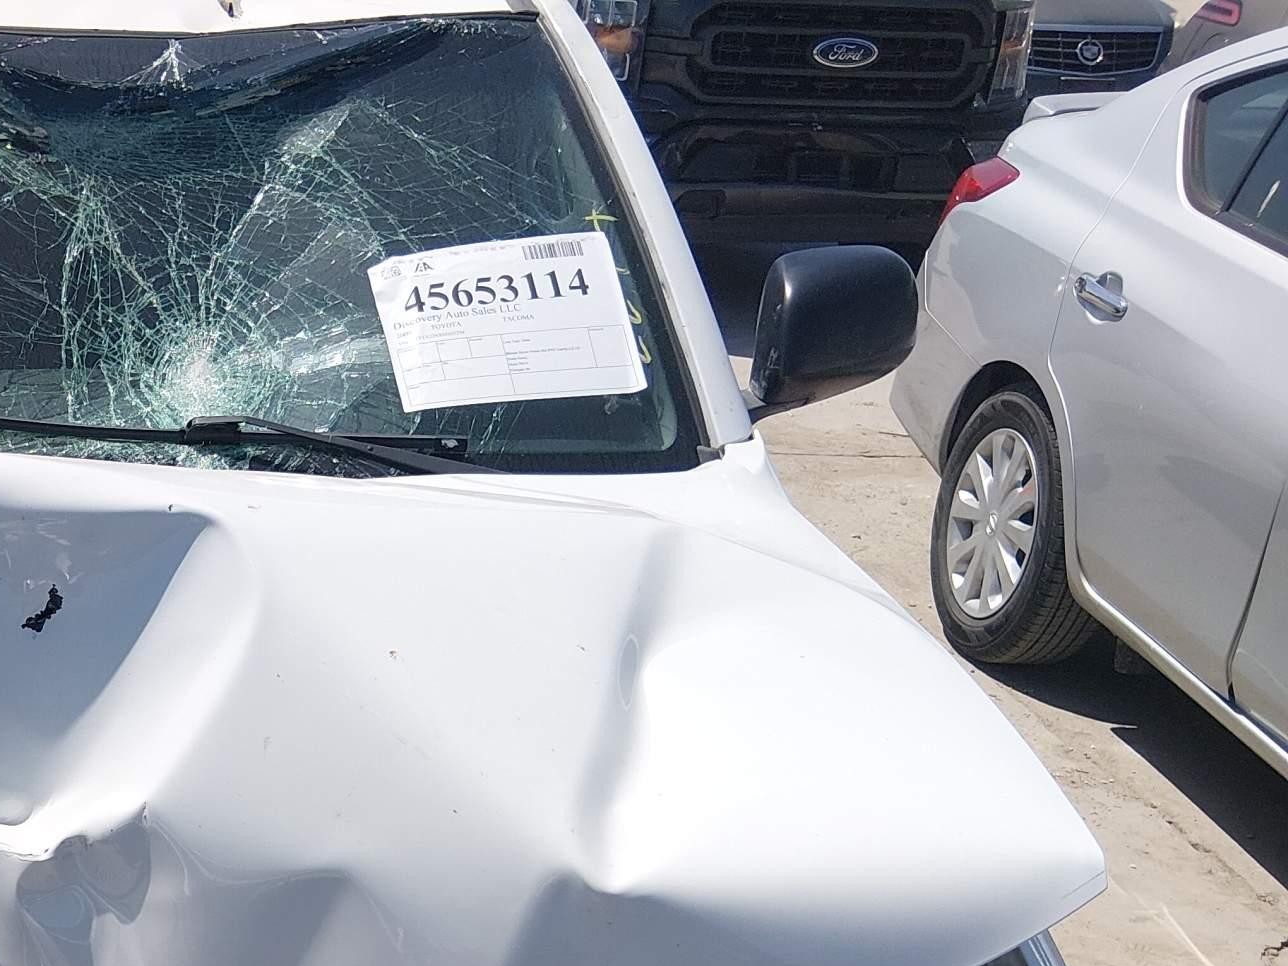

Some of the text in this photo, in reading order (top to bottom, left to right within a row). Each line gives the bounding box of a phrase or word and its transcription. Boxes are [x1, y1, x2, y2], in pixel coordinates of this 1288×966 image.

[829, 44, 864, 61] Ford
[405, 268, 589, 313] 45653114
[446, 309, 469, 320] Auto
[471, 306, 497, 317] Sales
[499, 304, 521, 314] LLC
[503, 314, 535, 322] TACOMA
[431, 321, 462, 330] TOYOTA
